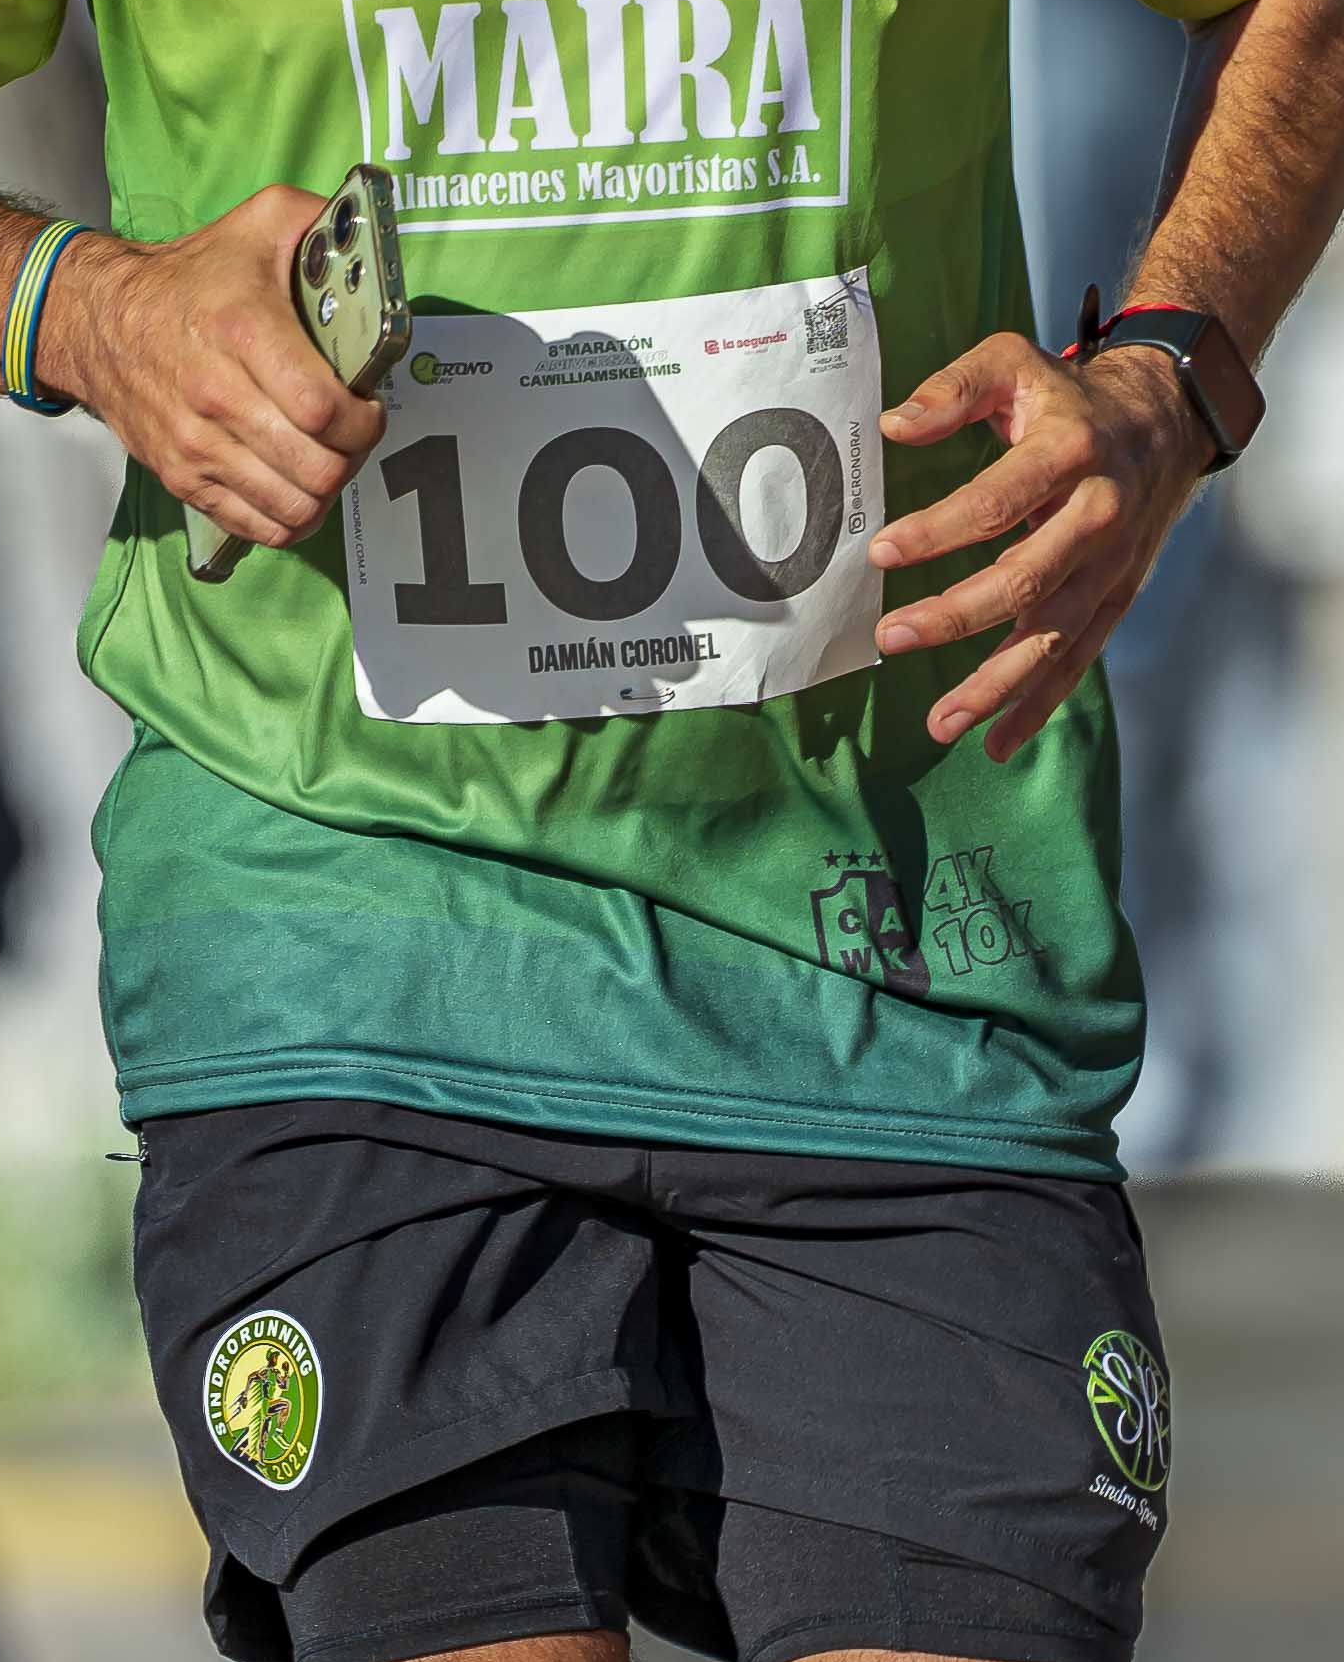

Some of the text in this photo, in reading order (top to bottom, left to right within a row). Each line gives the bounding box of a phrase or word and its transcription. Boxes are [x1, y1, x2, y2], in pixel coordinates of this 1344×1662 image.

[577, 153, 758, 203] Mayoristas
[767, 145, 822, 188] S.A.
[723, 331, 788, 350] la segunda
[519, 363, 682, 388] CAWILLIAMSKEMMIS
[380, 407, 844, 624] 100
[528, 633, 721, 674] DAMIÁN CORONEL
[922, 845, 1004, 914] 4K
[932, 898, 1047, 976] 10K
[209, 1319, 313, 1437] SINDRORUNNING
[272, 1441, 309, 1480] 2024
[1088, 1473, 1137, 1511] Sindro
